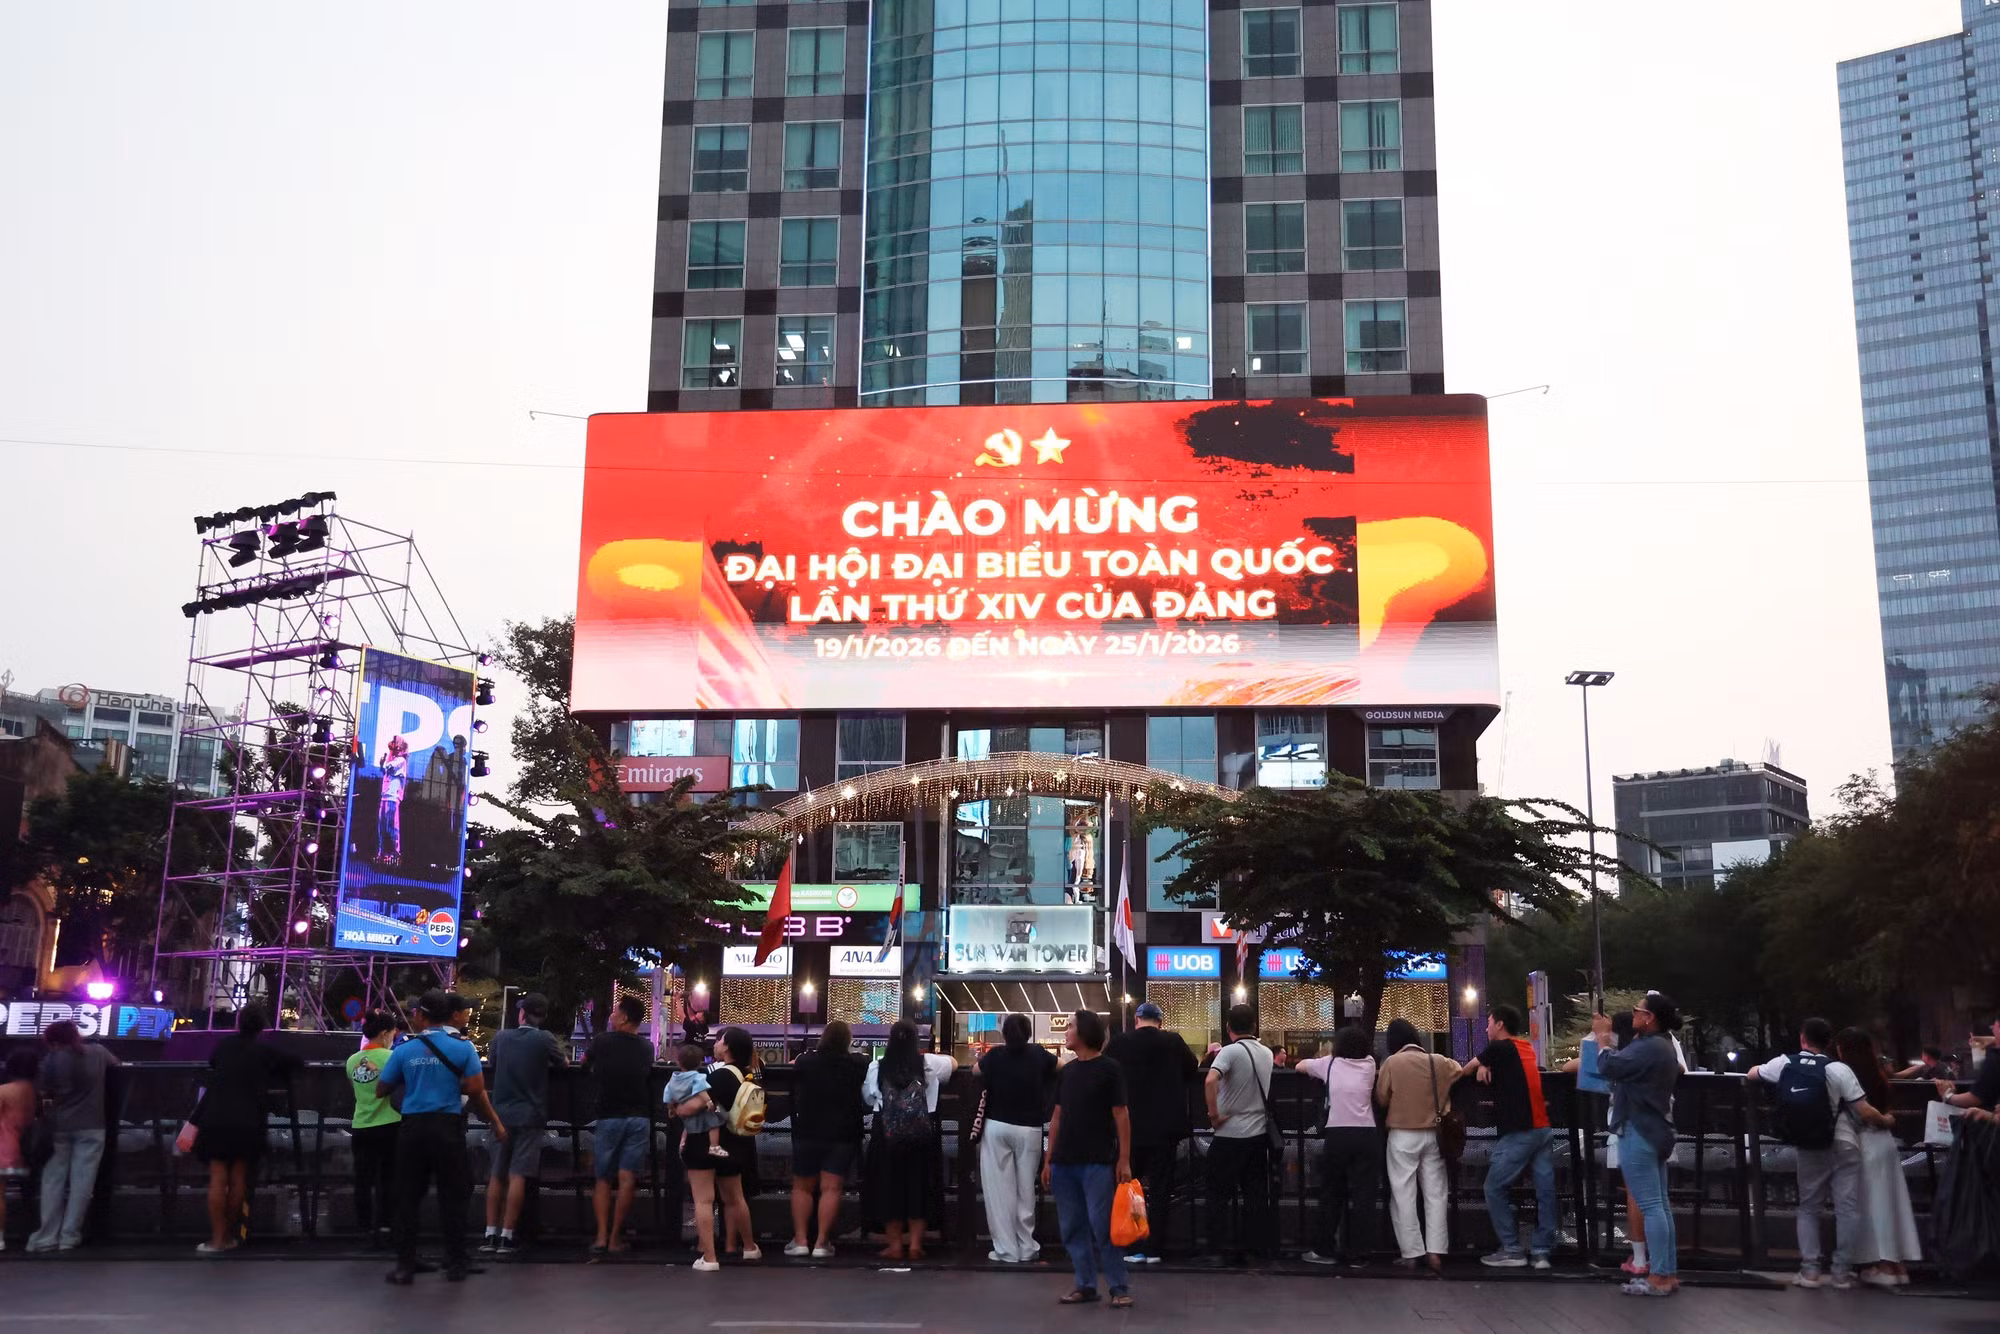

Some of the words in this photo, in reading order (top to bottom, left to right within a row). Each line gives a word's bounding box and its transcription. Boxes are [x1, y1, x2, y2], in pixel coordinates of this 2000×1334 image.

[841, 490, 1007, 539] CHÀO
[1023, 486, 1199, 535] MỪNG
[725, 552, 796, 590] ĐẠI
[809, 546, 880, 588] HỘI
[892, 551, 963, 587] ĐẠI
[976, 542, 1072, 579] BIỂU
[1082, 541, 1199, 577] TOÀN
[1211, 537, 1334, 579] QUỐC
[790, 583, 870, 622] LẦN
[882, 584, 967, 621] THỨ
[977, 593, 1046, 620] XIV
[1056, 582, 1143, 619] CỦA
[1153, 582, 1277, 618] ĐẢNG
[815, 636, 942, 660] 19/1/2026
[949, 632, 1014, 658] ĐẾN
[1018, 632, 1097, 657] NGÀY
[1105, 633, 1240, 657] 25/1/2026
[97, 693, 173, 713] Hanwha
[177, 702, 208, 715] Life
[1366, 711, 1411, 719] GOLDSUN
[1414, 711, 1444, 719] MEDIA
[615, 763, 704, 783] Emirates
[430, 924, 454, 934] PEPSI
[841, 951, 872, 963] ANA
[955, 944, 986, 961] SUN
[992, 944, 1028, 962] WAH
[1032, 944, 1088, 963] TOWER
[1174, 954, 1213, 971] UOB
[0, 1002, 112, 1036] EPSI
[409, 1057, 443, 1067] SECURI
